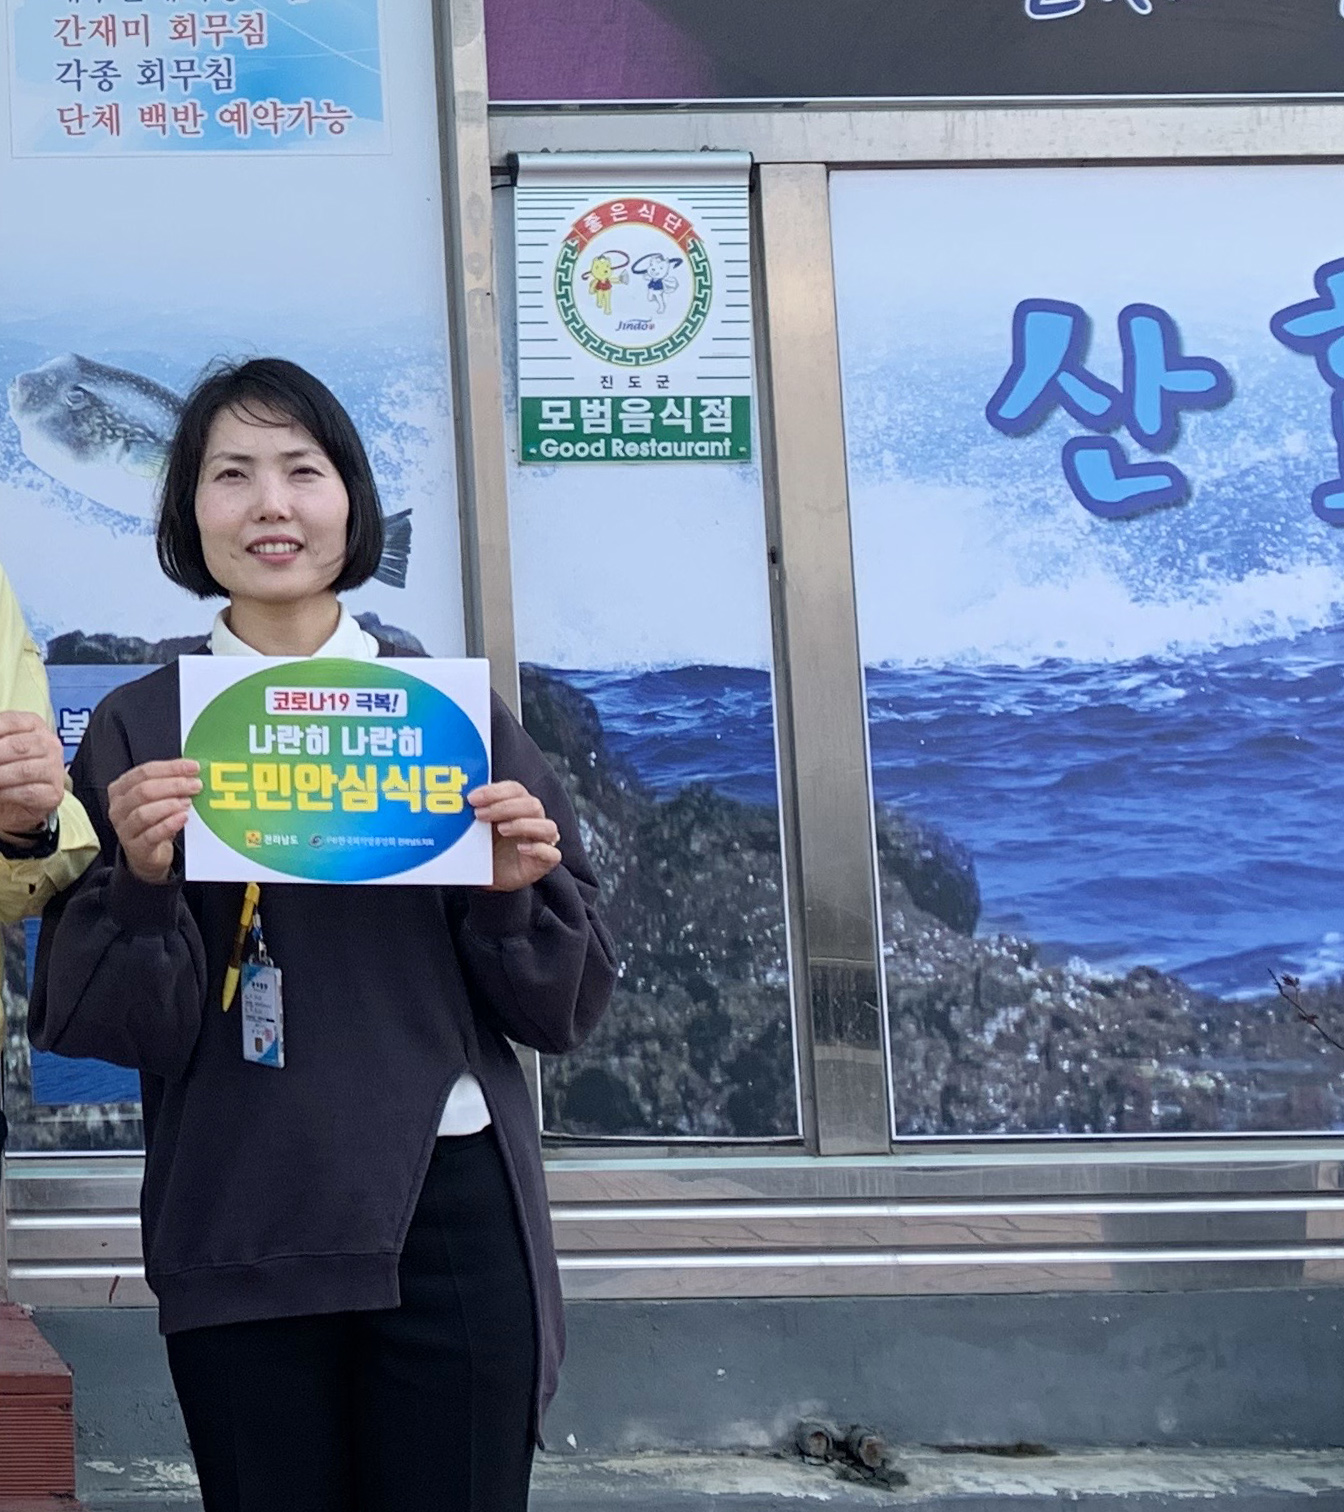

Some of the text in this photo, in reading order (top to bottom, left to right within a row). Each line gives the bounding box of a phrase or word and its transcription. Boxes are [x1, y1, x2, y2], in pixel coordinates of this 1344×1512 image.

[54, 12, 268, 48] 간재미 회무침
[55, 57, 236, 92] 각종 회무침
[57, 101, 354, 137] 단체 백반 예약가능
[583, 202, 683, 234] 좋은식단
[600, 375, 670, 390] 진도군
[538, 397, 733, 435] 모범음식점
[540, 438, 732, 458] Good Restaurant
[272, 691, 400, 714] 코로나19 극복!
[248, 724, 423, 757] 나란히 나란히
[209, 761, 468, 814] 도민안심식당
